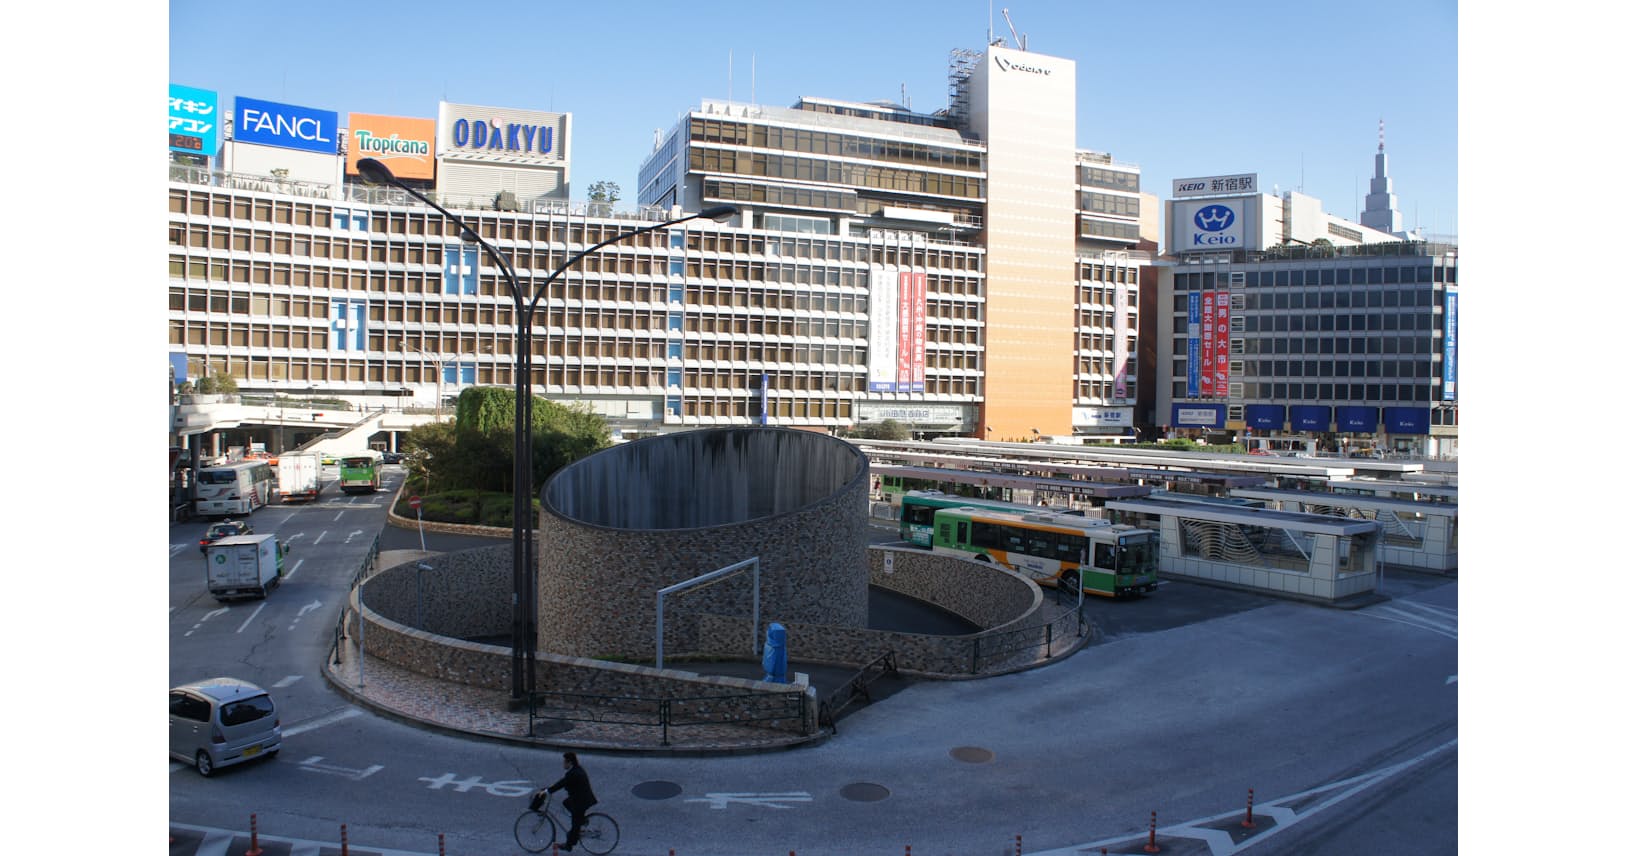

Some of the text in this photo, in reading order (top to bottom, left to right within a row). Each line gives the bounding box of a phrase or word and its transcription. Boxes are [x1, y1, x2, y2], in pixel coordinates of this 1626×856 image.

[243, 108, 331, 143] FANCL
[454, 117, 554, 154] ODAKYU
[355, 130, 429, 155] Tropicana
[1178, 176, 1253, 192] KEIO 新宿駅
[1193, 232, 1236, 246] Keio
